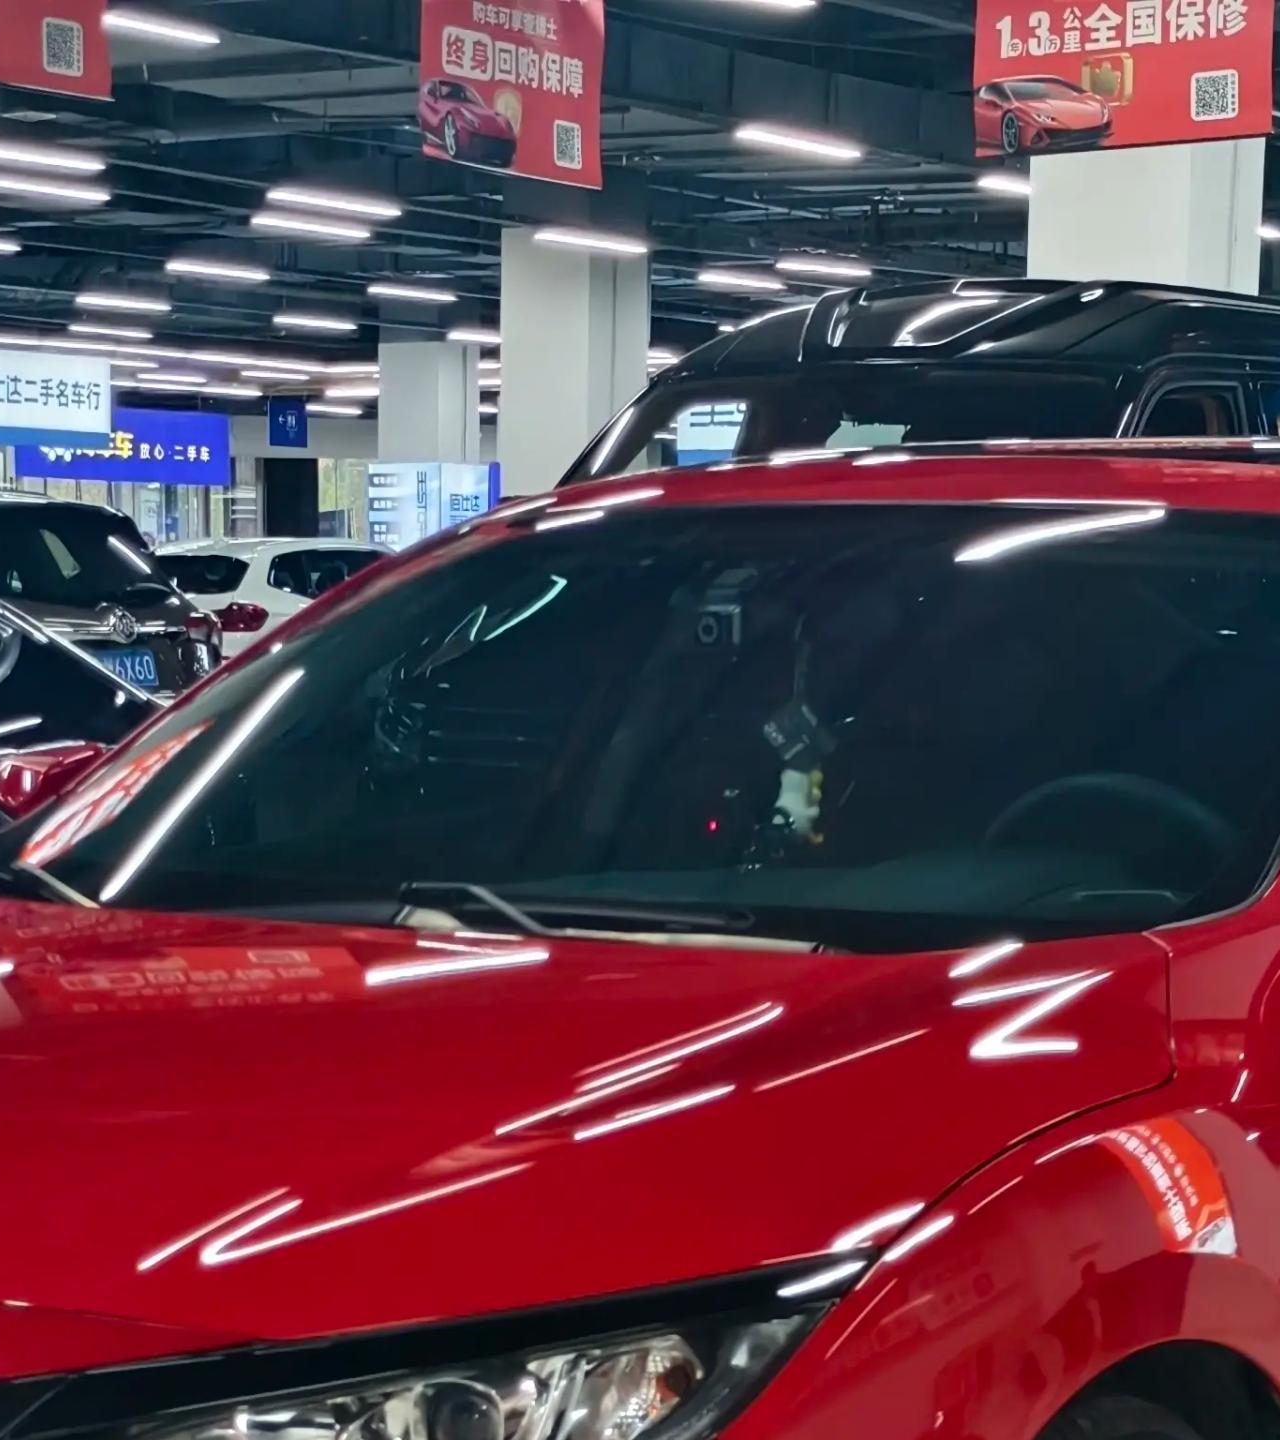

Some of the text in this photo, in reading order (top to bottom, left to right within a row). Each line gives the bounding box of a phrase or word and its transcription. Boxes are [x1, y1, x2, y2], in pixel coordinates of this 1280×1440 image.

[443, 28, 584, 98] 终身回购保障
